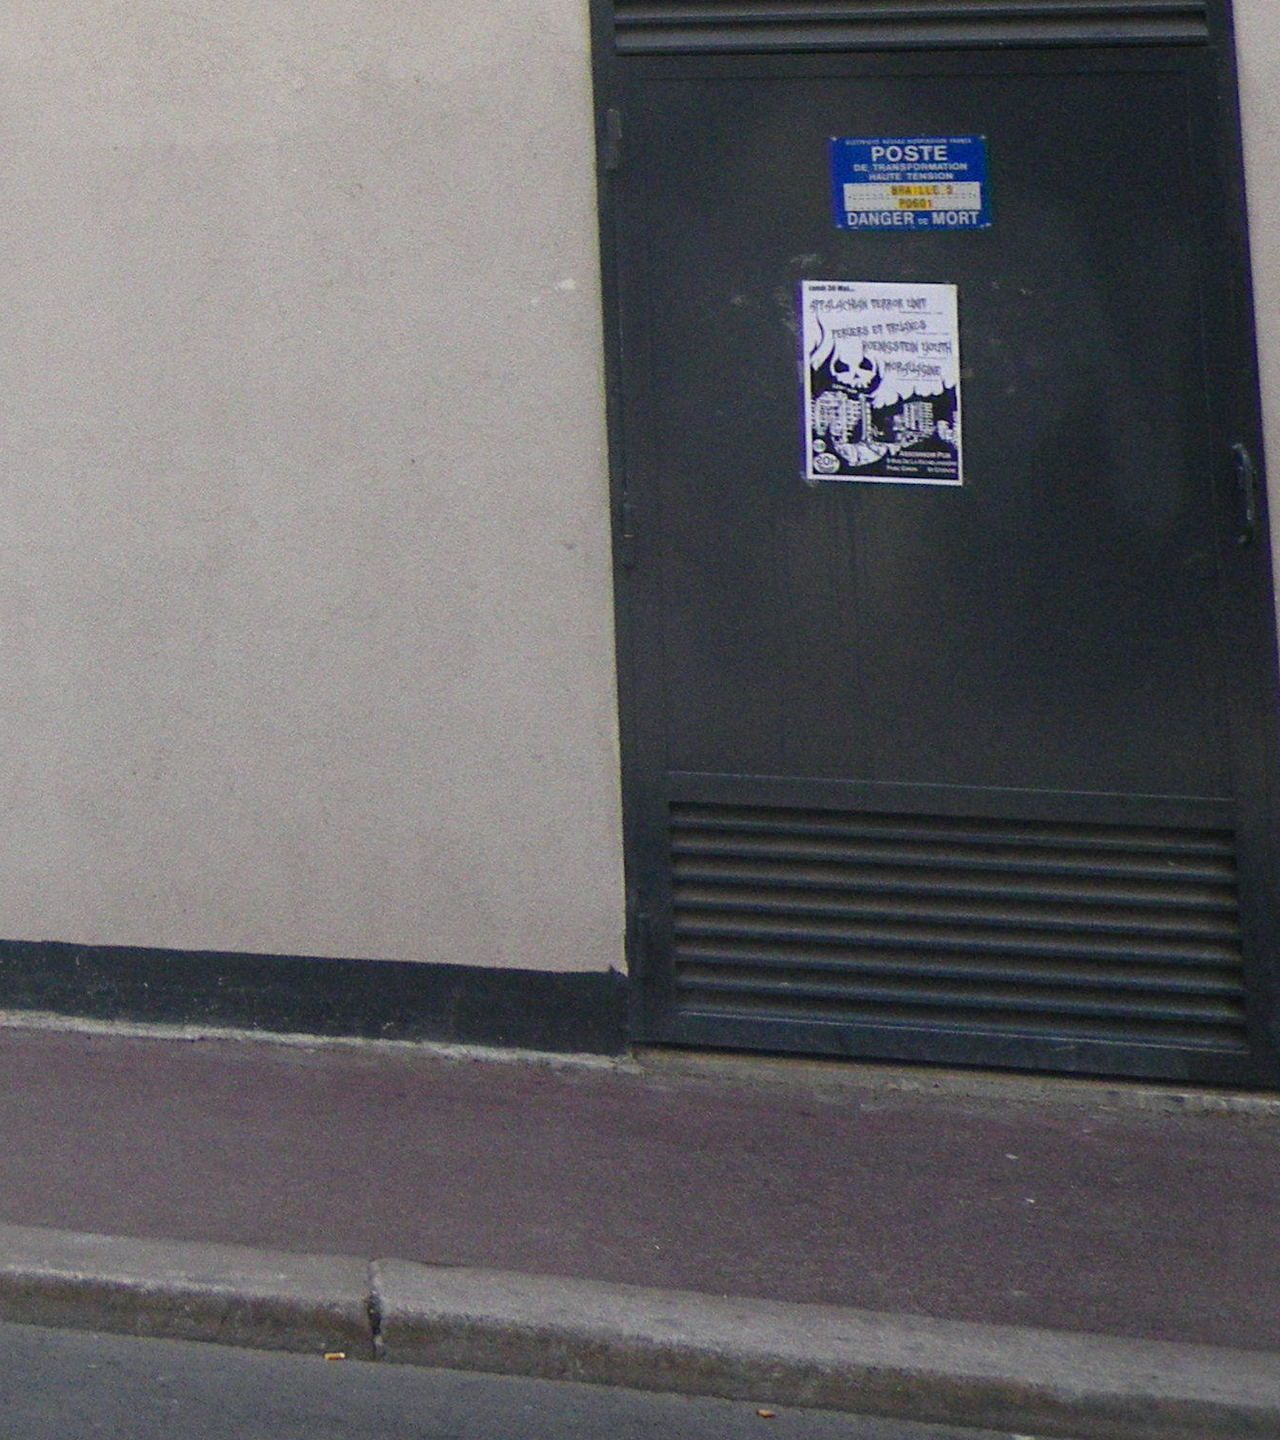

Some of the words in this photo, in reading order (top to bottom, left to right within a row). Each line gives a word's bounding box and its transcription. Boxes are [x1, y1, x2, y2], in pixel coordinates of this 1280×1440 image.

[871, 145, 948, 162] POSTE
[853, 163, 869, 172] DE
[872, 162, 968, 172] TRANSFORMATION
[869, 172, 903, 181] HAUTE
[906, 171, 954, 181] TENSION
[847, 211, 915, 226] DANGER
[932, 211, 980, 226] MORT
